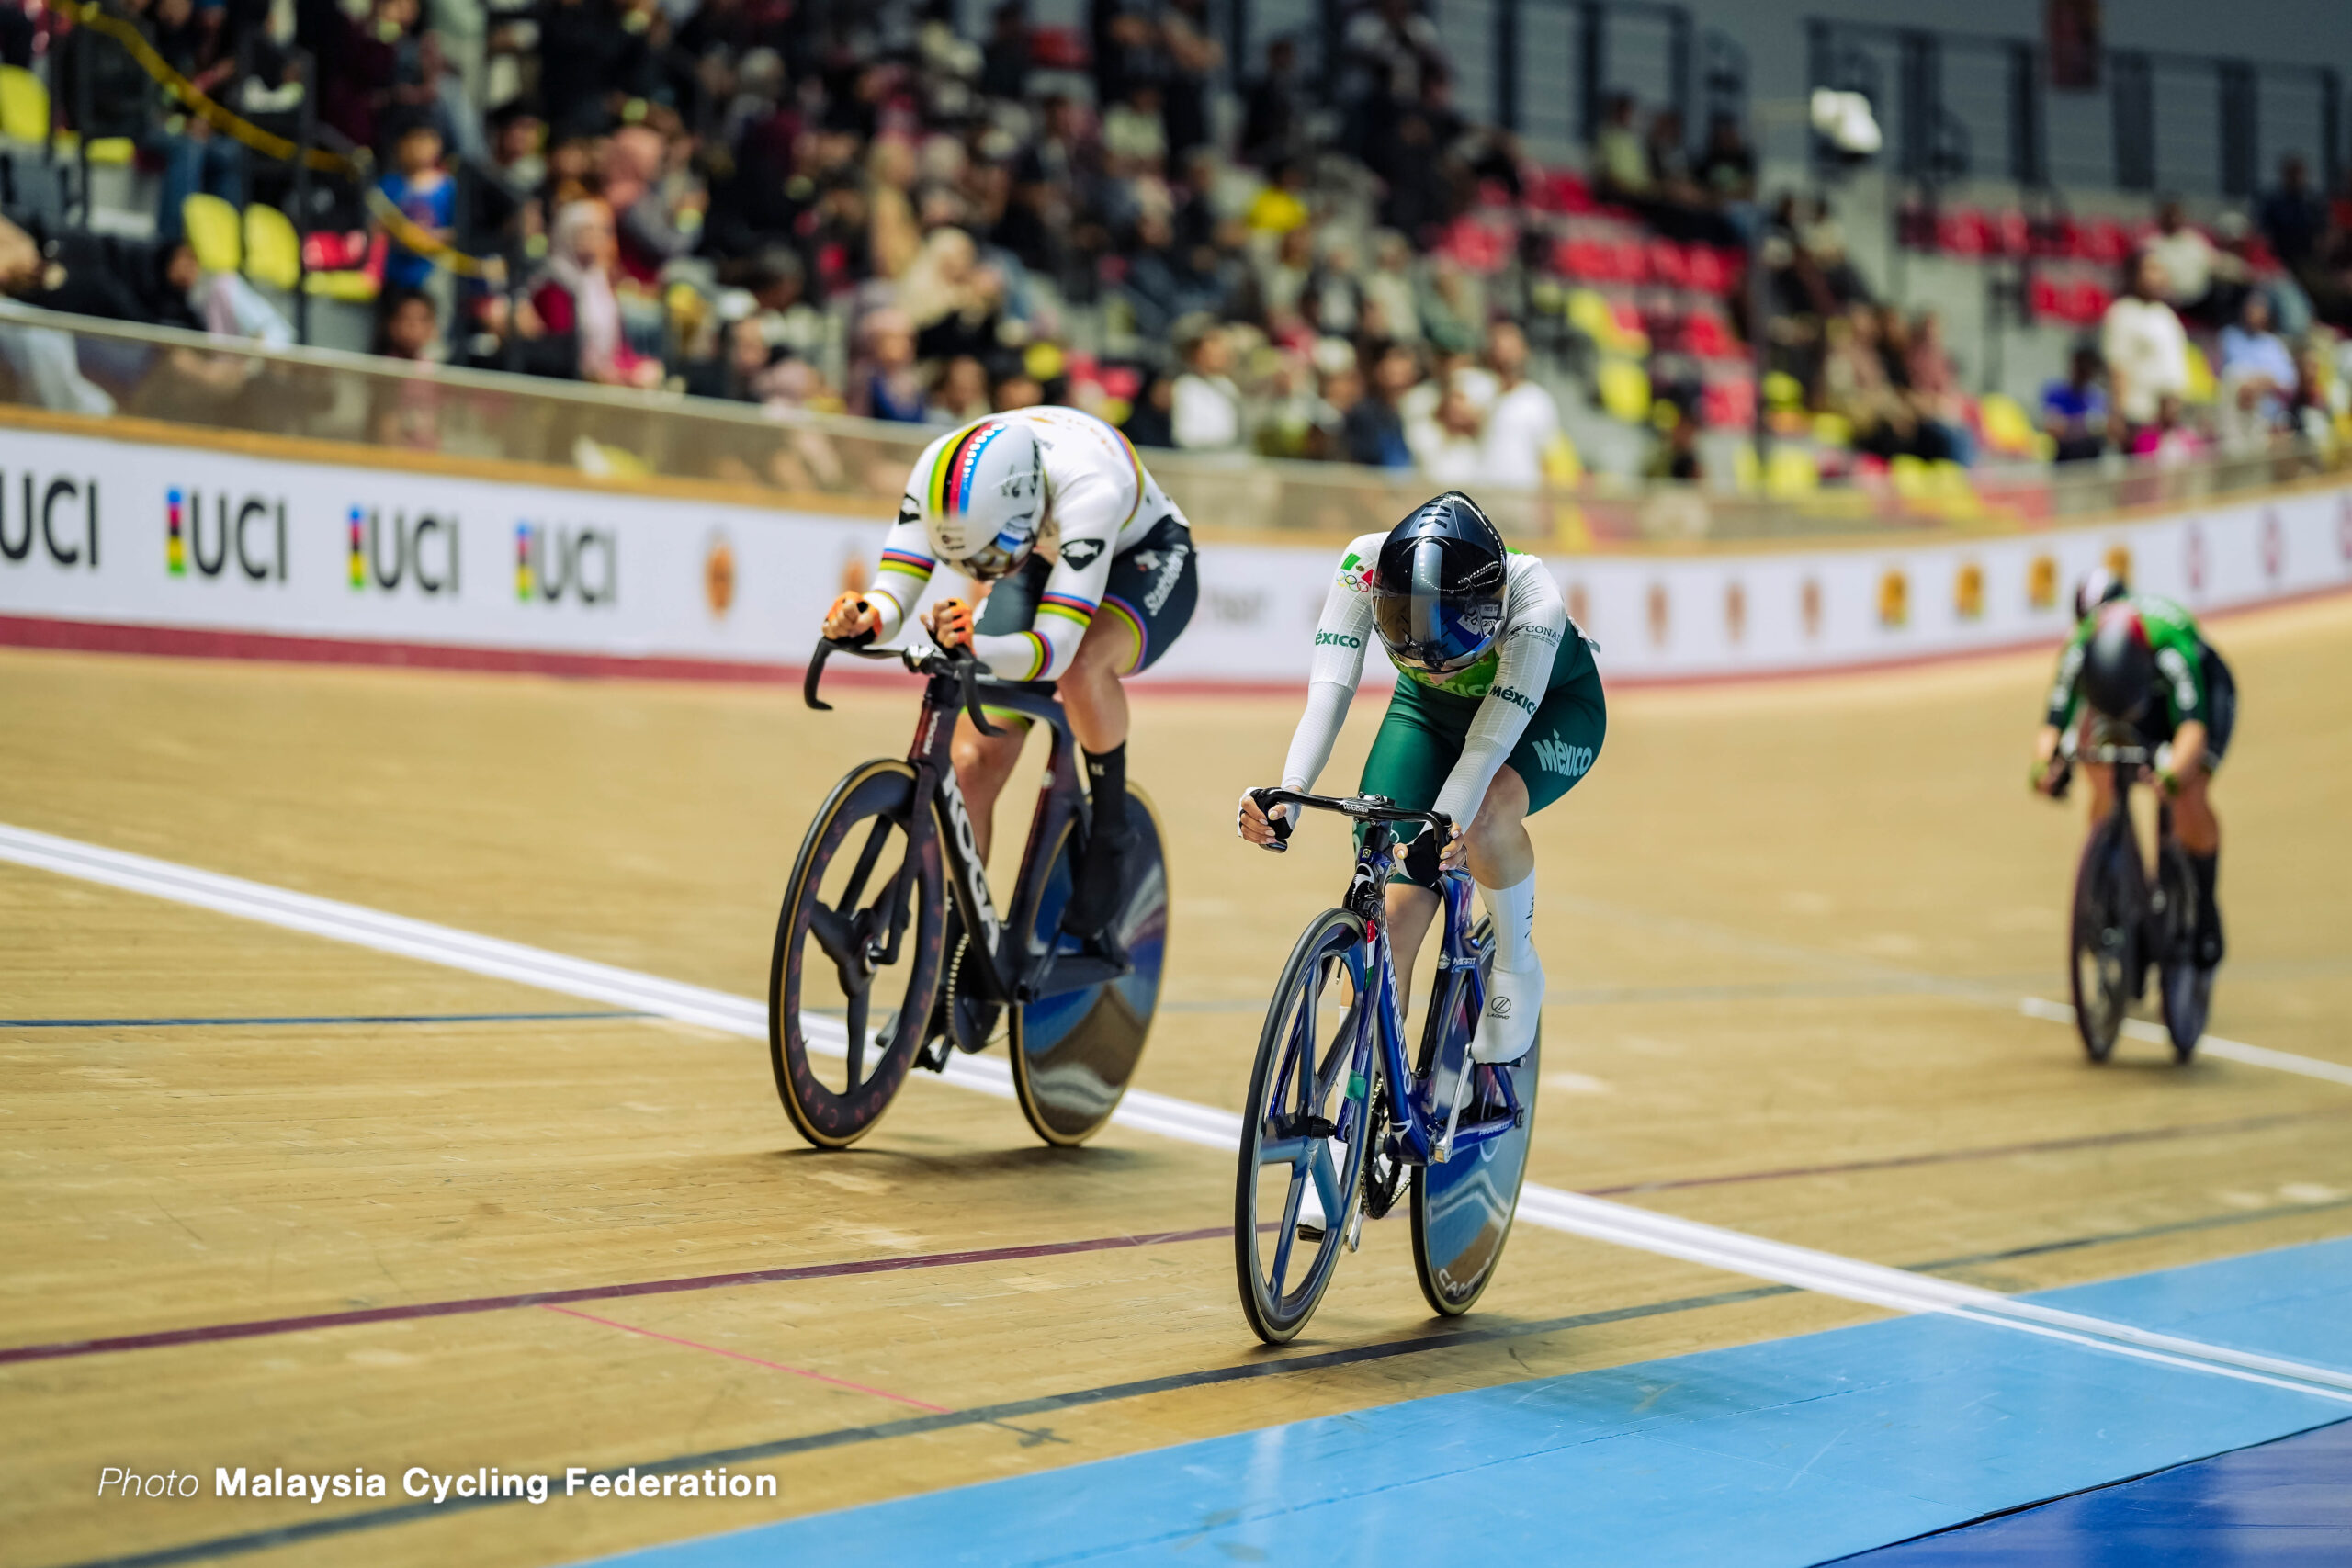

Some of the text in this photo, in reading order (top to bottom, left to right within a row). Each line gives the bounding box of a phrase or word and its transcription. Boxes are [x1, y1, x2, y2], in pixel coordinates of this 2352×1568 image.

[0, 470, 96, 568] UCI
[189, 491, 285, 581] UCI
[369, 508, 458, 592] UCI
[535, 520, 616, 606] UCI
[943, 764, 1001, 957] KOGA
